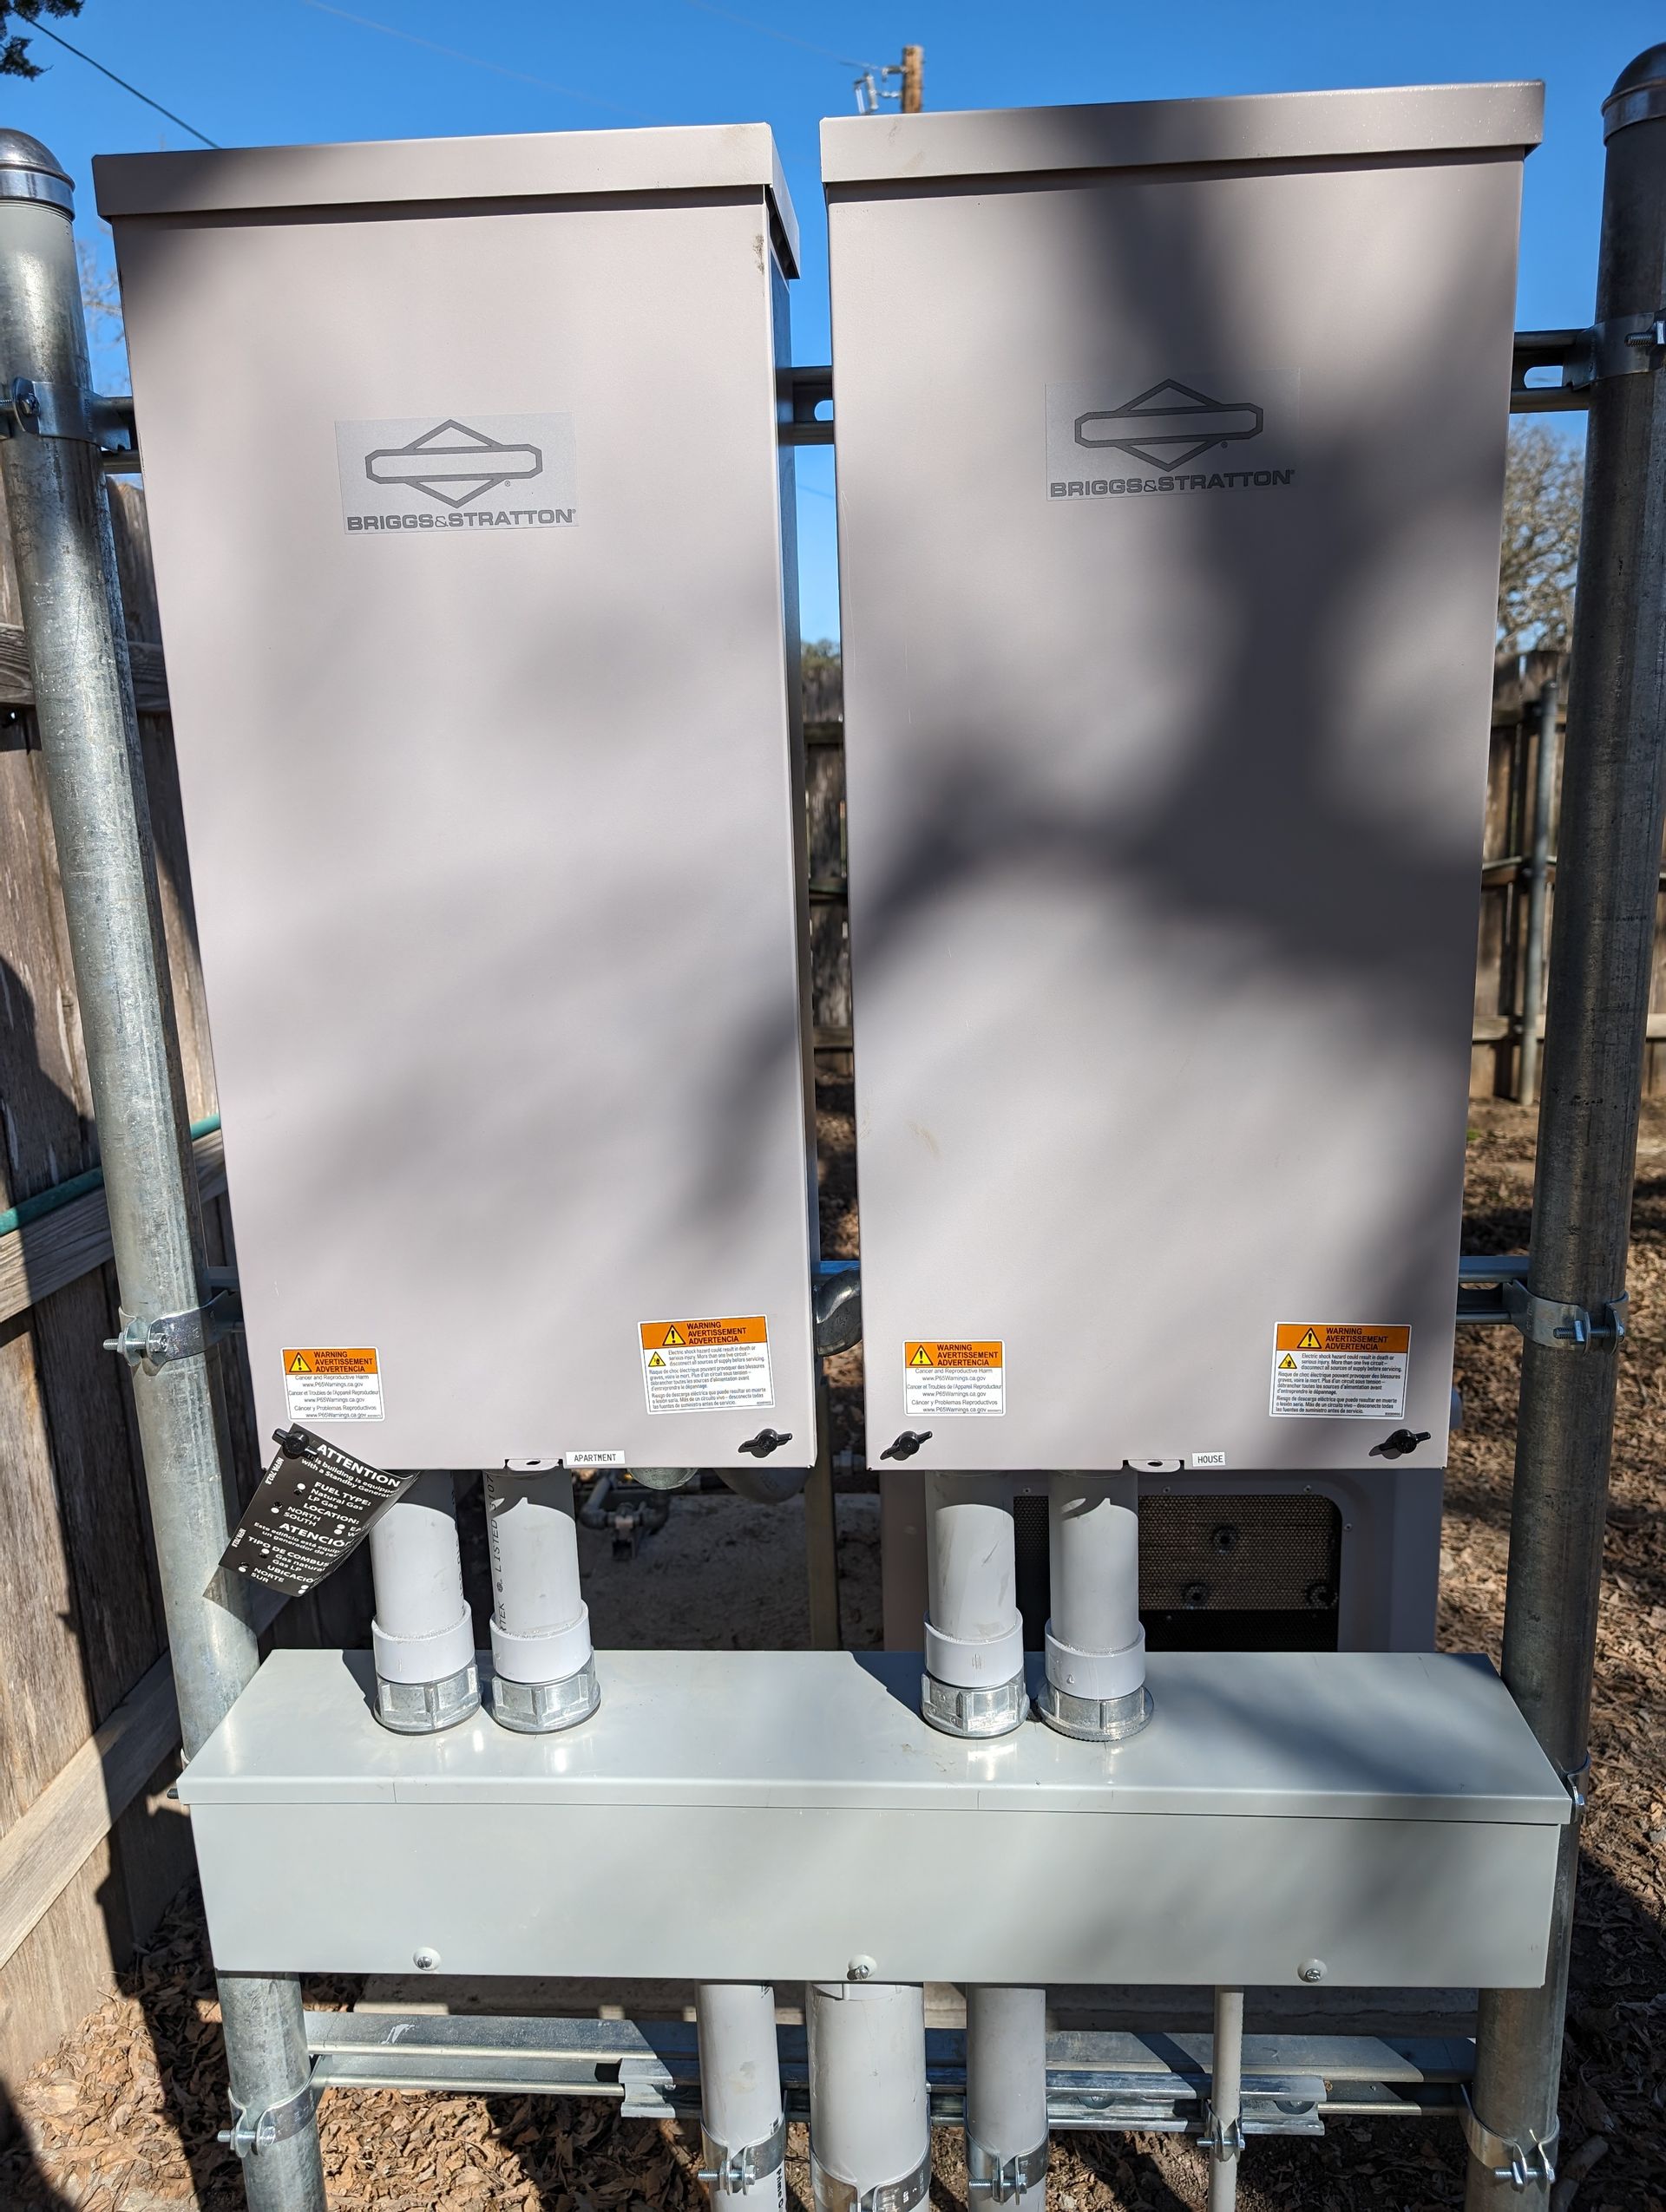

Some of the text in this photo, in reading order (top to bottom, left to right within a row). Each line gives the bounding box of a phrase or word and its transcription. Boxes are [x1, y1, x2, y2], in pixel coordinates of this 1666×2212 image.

[687, 1327, 746, 1337] AVERTISSEMENT
[1326, 1335, 1388, 1344] AVERTISSEMENT
[689, 1336, 739, 1345] ADVERTENCIA
[317, 1444, 400, 1487] ATTENTION
[574, 1454, 616, 1463] APARTMENT
[1197, 1455, 1223, 1463] HOUSE
[302, 1459, 318, 1470] with
[325, 1470, 357, 1488] Standby
[357, 1485, 390, 1497] Generat
[322, 1462, 354, 1481] building
[311, 1489, 344, 1504] Natural
[314, 1482, 371, 1506] FUEL TYPE:
[321, 1500, 338, 1509] Gas
[284, 1512, 317, 1527] SOUTH
[287, 1506, 321, 1522] NORTH
[303, 1502, 360, 1525] LOCATION:
[254, 1522, 270, 1531] Este
[271, 1529, 299, 1542] edificio
[279, 1523, 345, 1547] ATENCIÓ
[273, 1535, 313, 1551] generador
[491, 1520, 502, 1572] LISTED
[248, 1536, 271, 1548] TIPO
[272, 1546, 286, 1554] DE
[287, 1552, 330, 1567] COMBUS
[272, 1560, 288, 1568] Gas
[275, 1554, 325, 1572] Gas natural
[251, 1572, 269, 1582] SUR
[254, 1567, 285, 1582] NORTE
